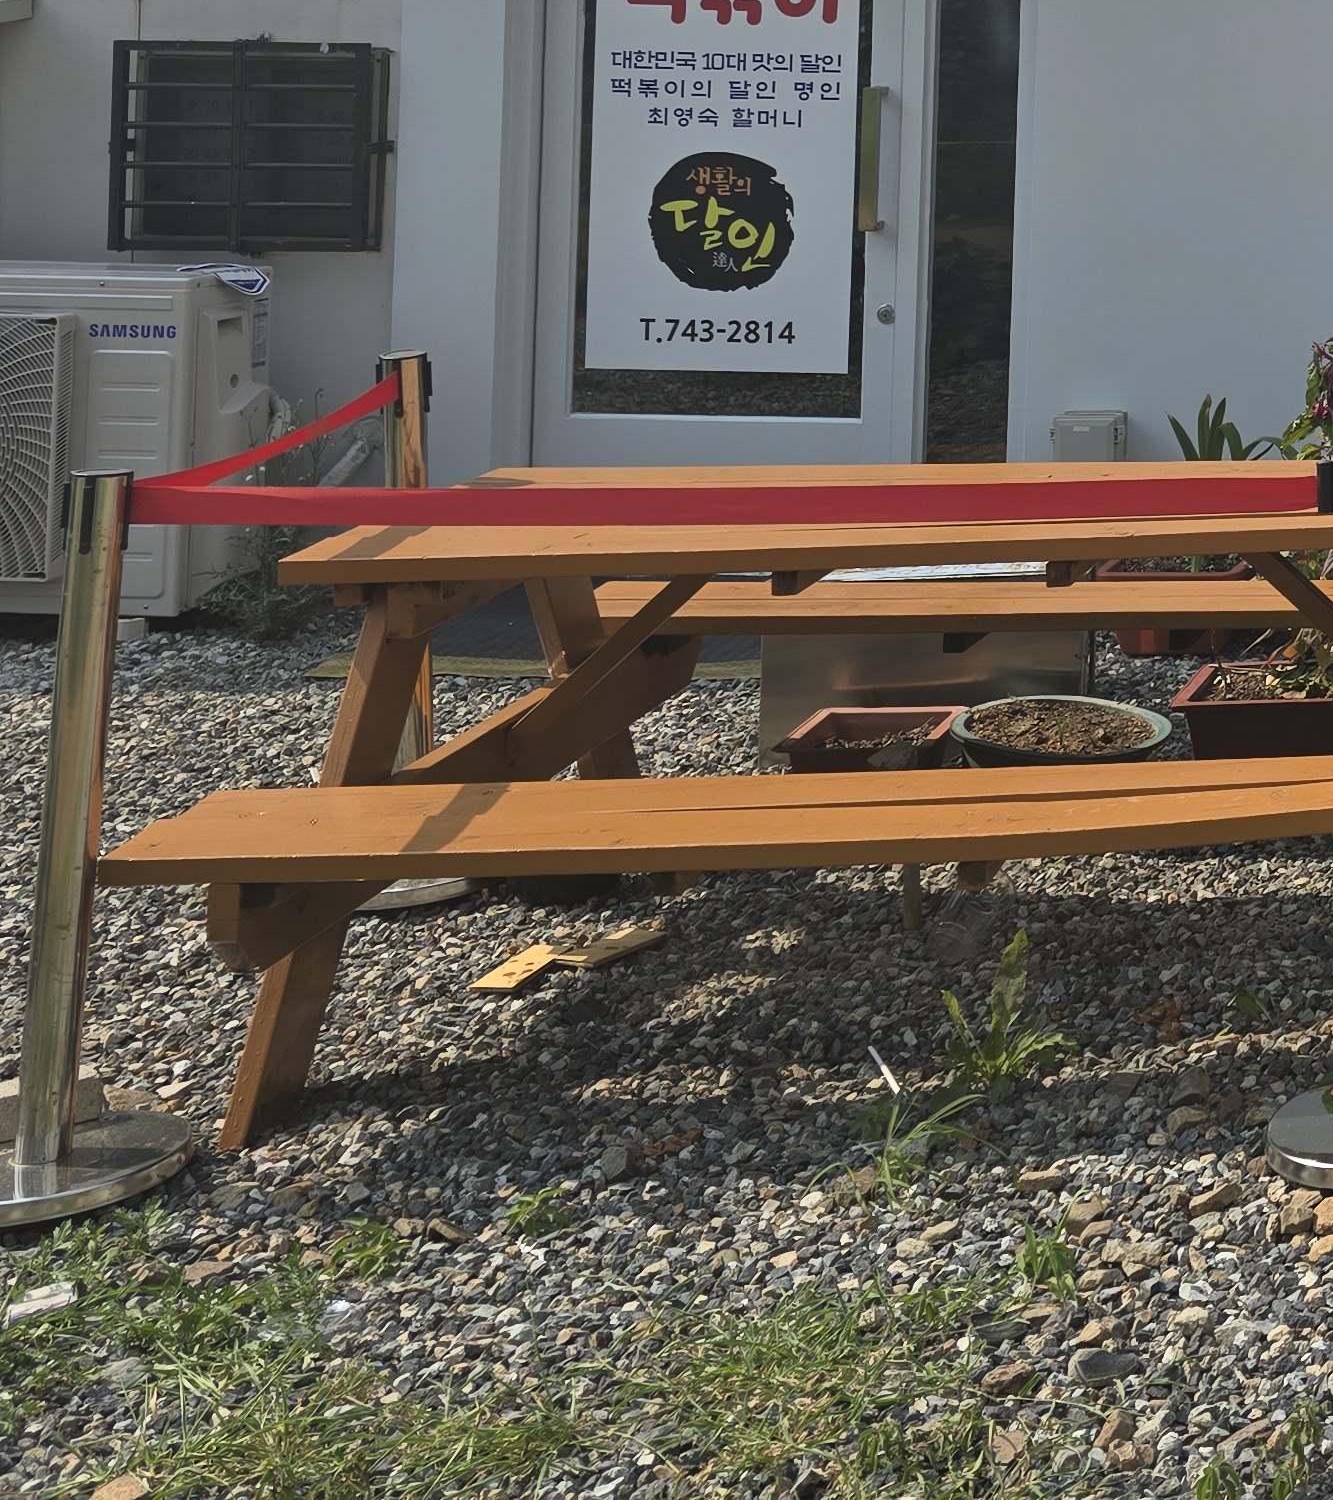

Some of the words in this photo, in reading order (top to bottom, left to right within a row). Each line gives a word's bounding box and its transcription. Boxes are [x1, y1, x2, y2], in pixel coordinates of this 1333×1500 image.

[611, 50, 697, 71] 대한민국
[701, 52, 747, 72] 10대
[752, 53, 794, 73] 맛의
[799, 54, 842, 74] 달인
[611, 78, 712, 99] 떡볶이의
[728, 80, 776, 100] 달인
[793, 81, 841, 101] 명인
[647, 107, 719, 127] 최영숙
[732, 108, 803, 128] 할머니
[686, 166, 752, 196] 생활의
[660, 196, 776, 272] 달인
[89, 323, 178, 340] SAMSUNG
[640, 318, 796, 344] T.743-2814
